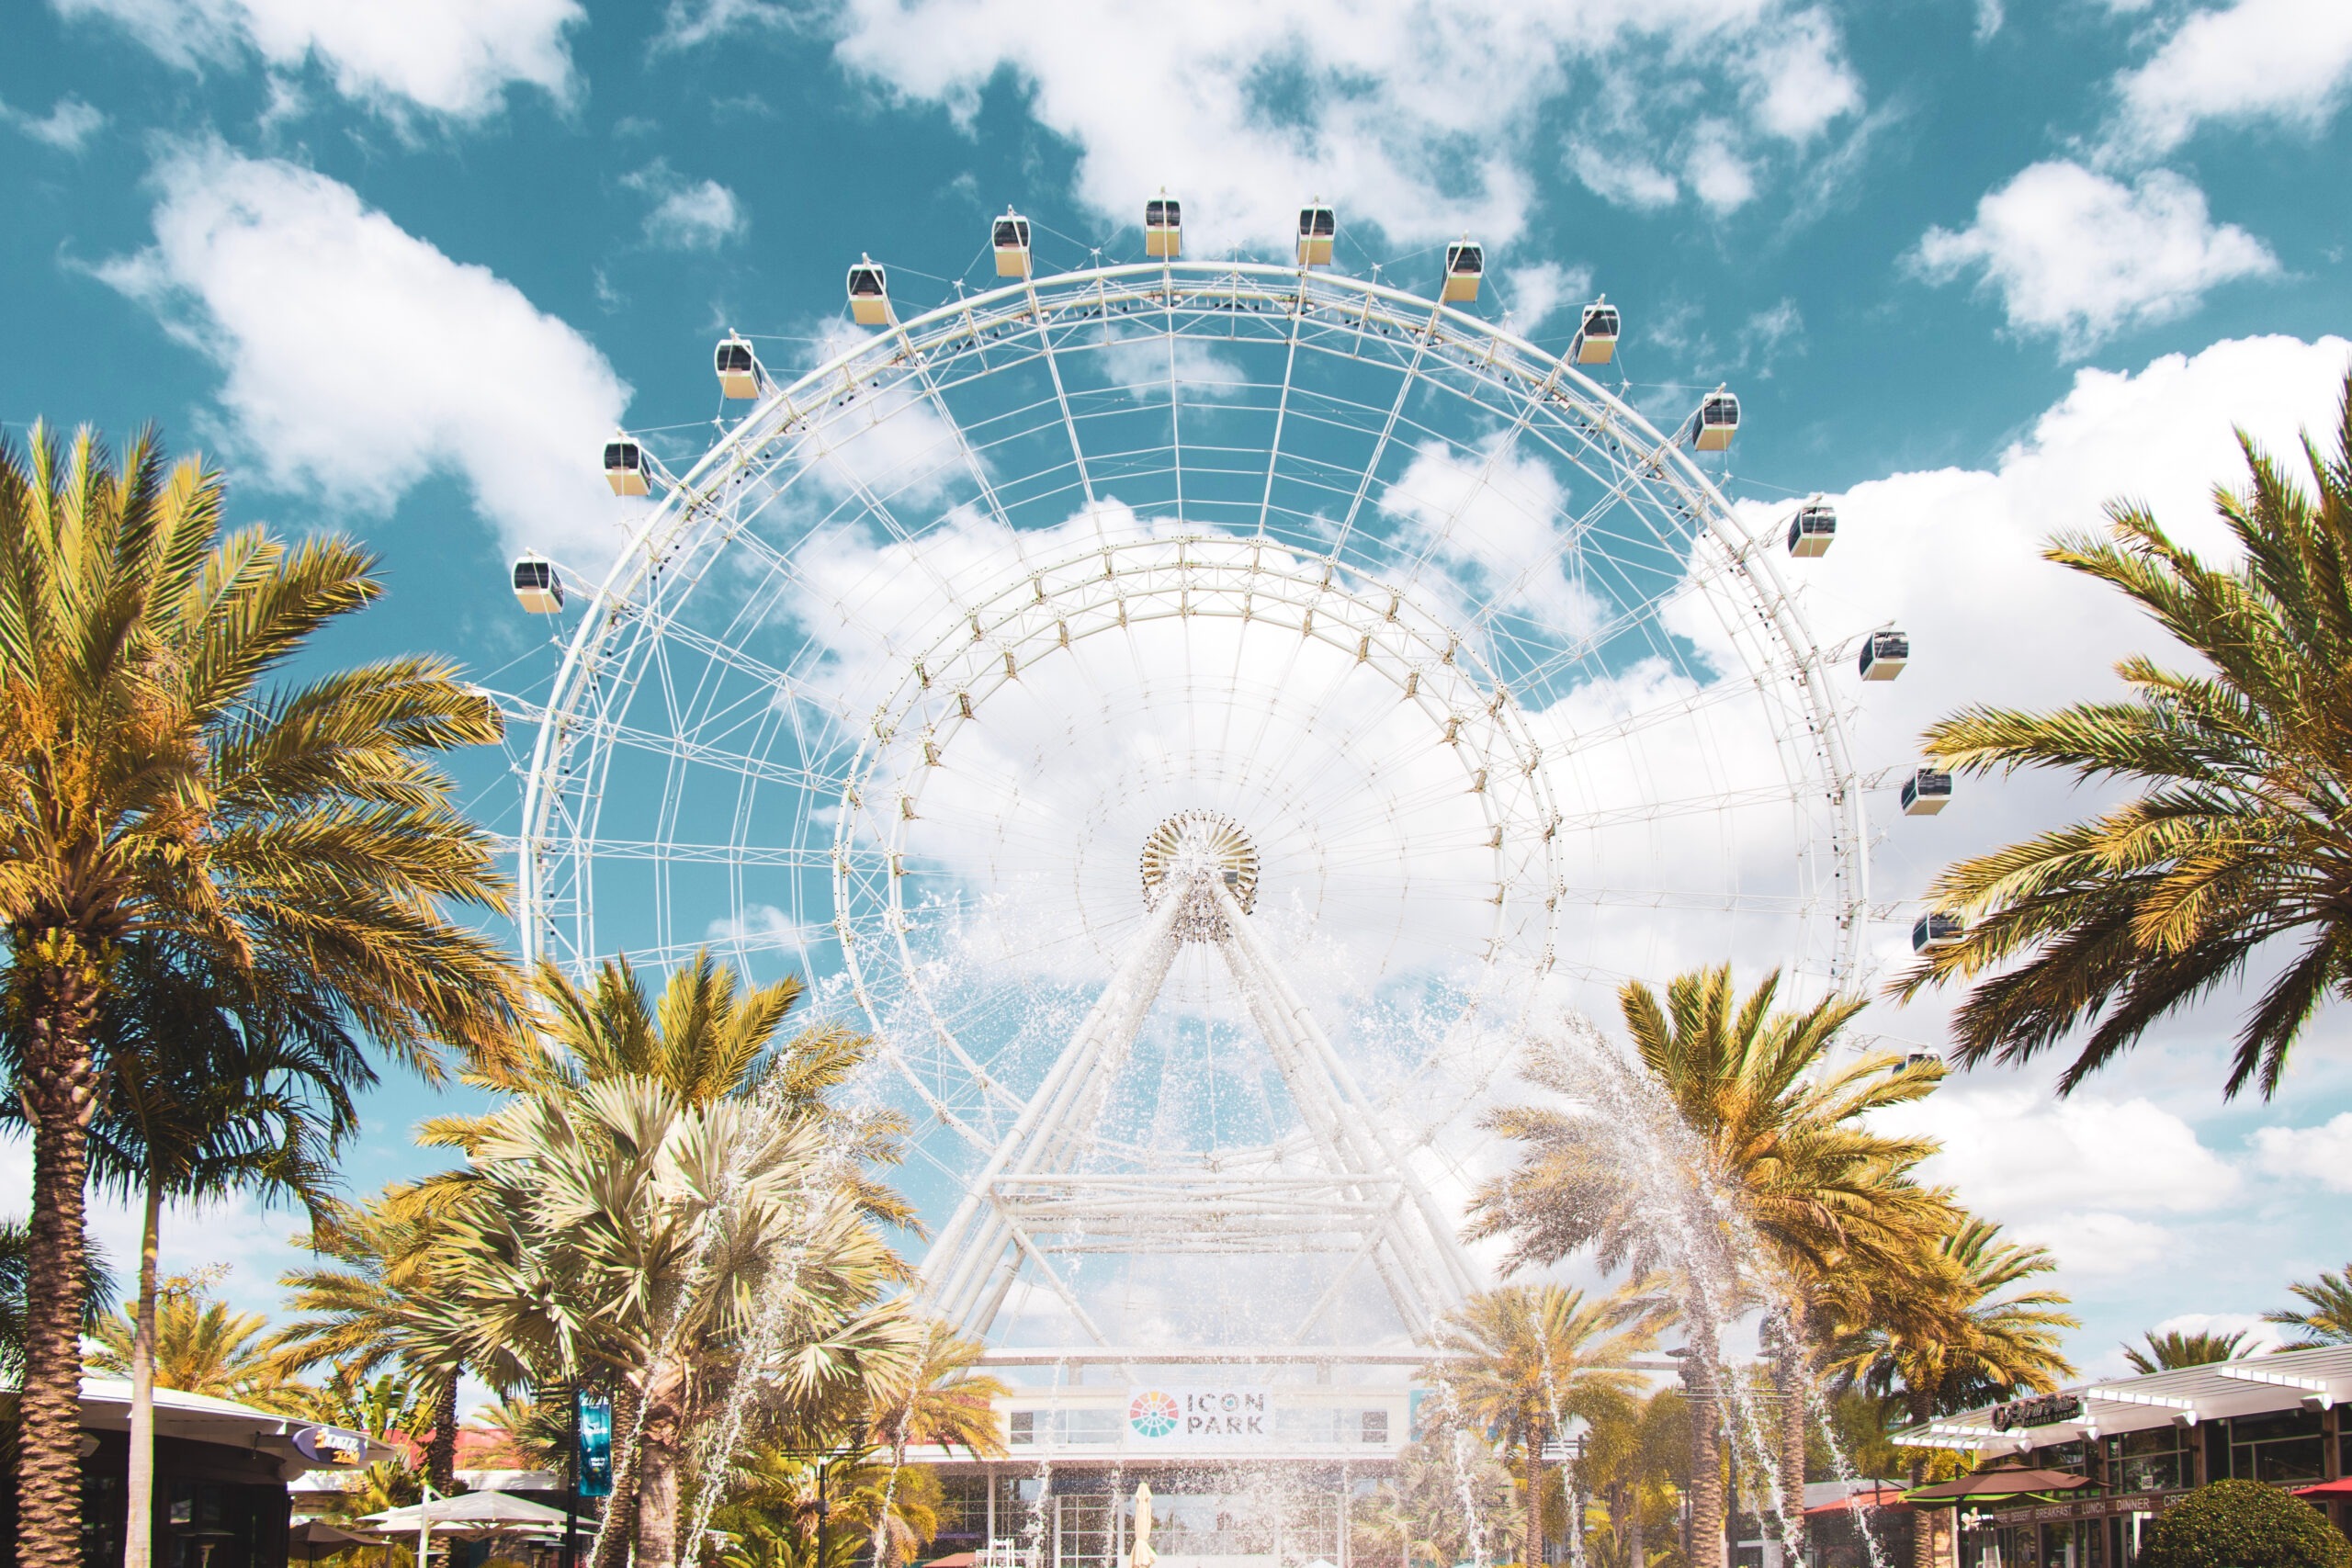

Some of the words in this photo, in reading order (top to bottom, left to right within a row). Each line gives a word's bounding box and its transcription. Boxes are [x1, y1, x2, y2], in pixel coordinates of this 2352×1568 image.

[1188, 1393, 1263, 1412] ICON
[1188, 1416, 1263, 1434] PARK
[2025, 1416, 2052, 1427] COFFEE
[2054, 1411, 2074, 1421] SHOP
[2010, 1509, 2031, 1522] DESSERT
[2035, 1506, 2072, 1519] BREAKFAST
[2081, 1502, 2105, 1515] LUNCH
[2116, 1498, 2150, 1511] DINNER
